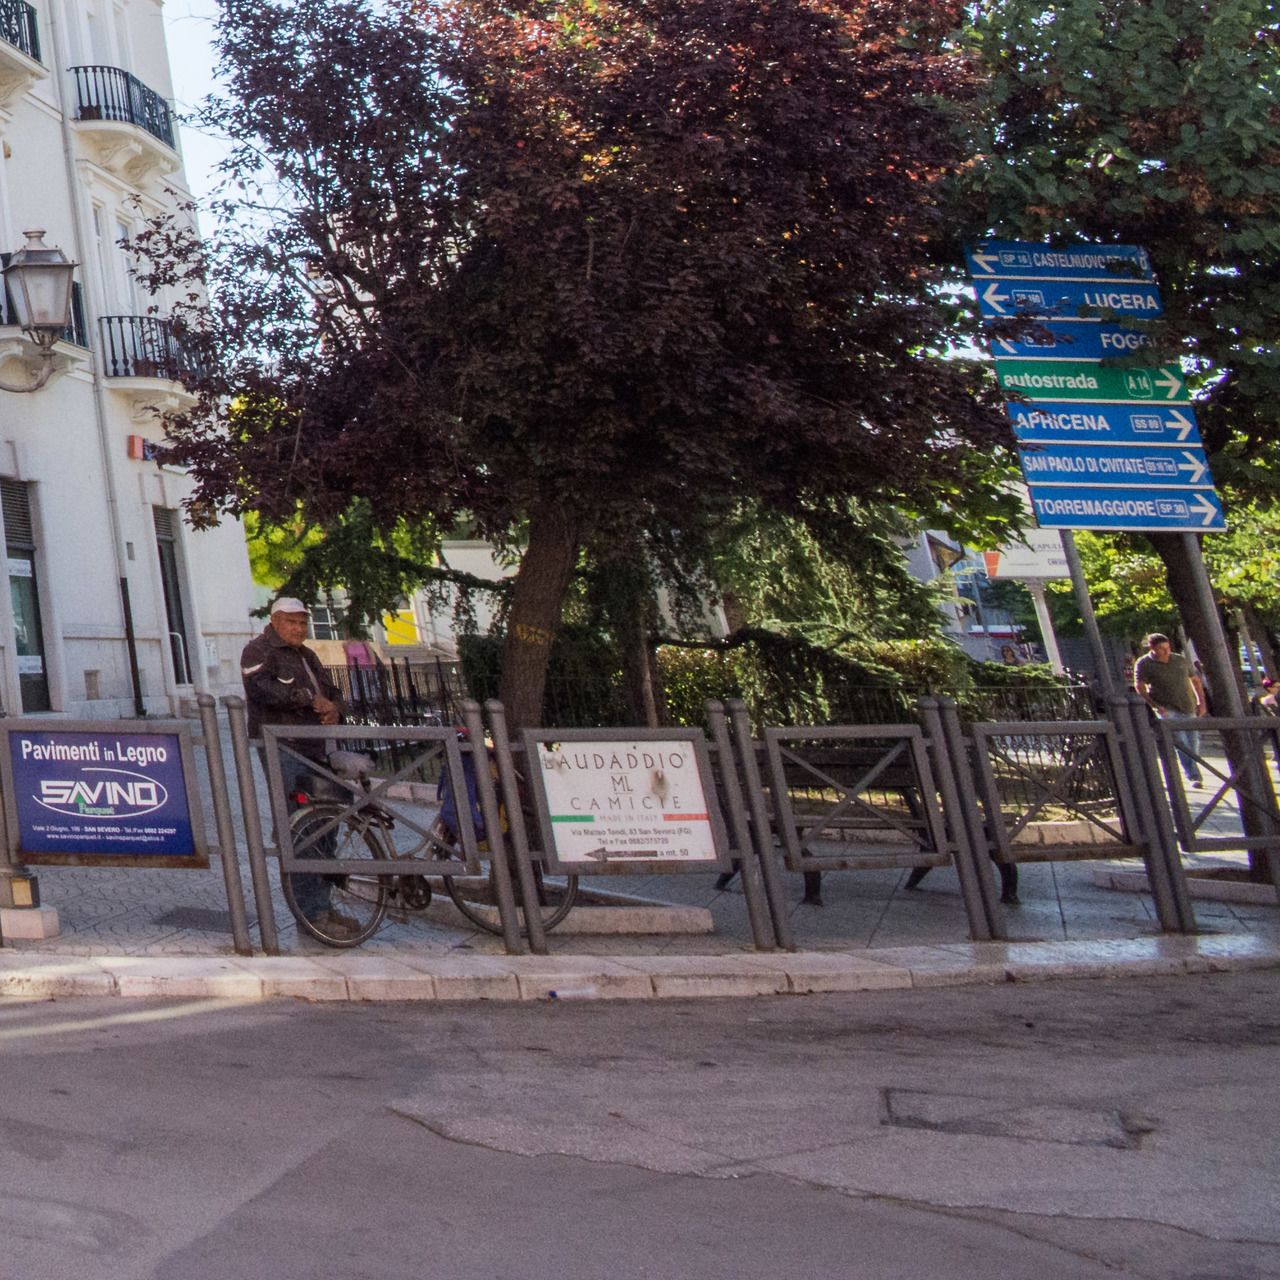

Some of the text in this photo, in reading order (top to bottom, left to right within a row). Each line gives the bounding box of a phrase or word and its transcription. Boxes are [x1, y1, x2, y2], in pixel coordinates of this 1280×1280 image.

[1084, 293, 1159, 310] LUCERA
[1003, 374, 1098, 390] autostrada
[1128, 374, 1150, 391] A 14
[1016, 412, 1111, 431] APRICENA
[1024, 457, 1145, 474] SAN PAOLO DI CIVITATE
[1035, 498, 1156, 516] TORREMAGGIORE
[21, 739, 167, 767] Pavimenti in Legno
[611, 775, 634, 792] ML
[40, 780, 158, 806] SAVINO
[570, 795, 681, 811] CAMICIE
